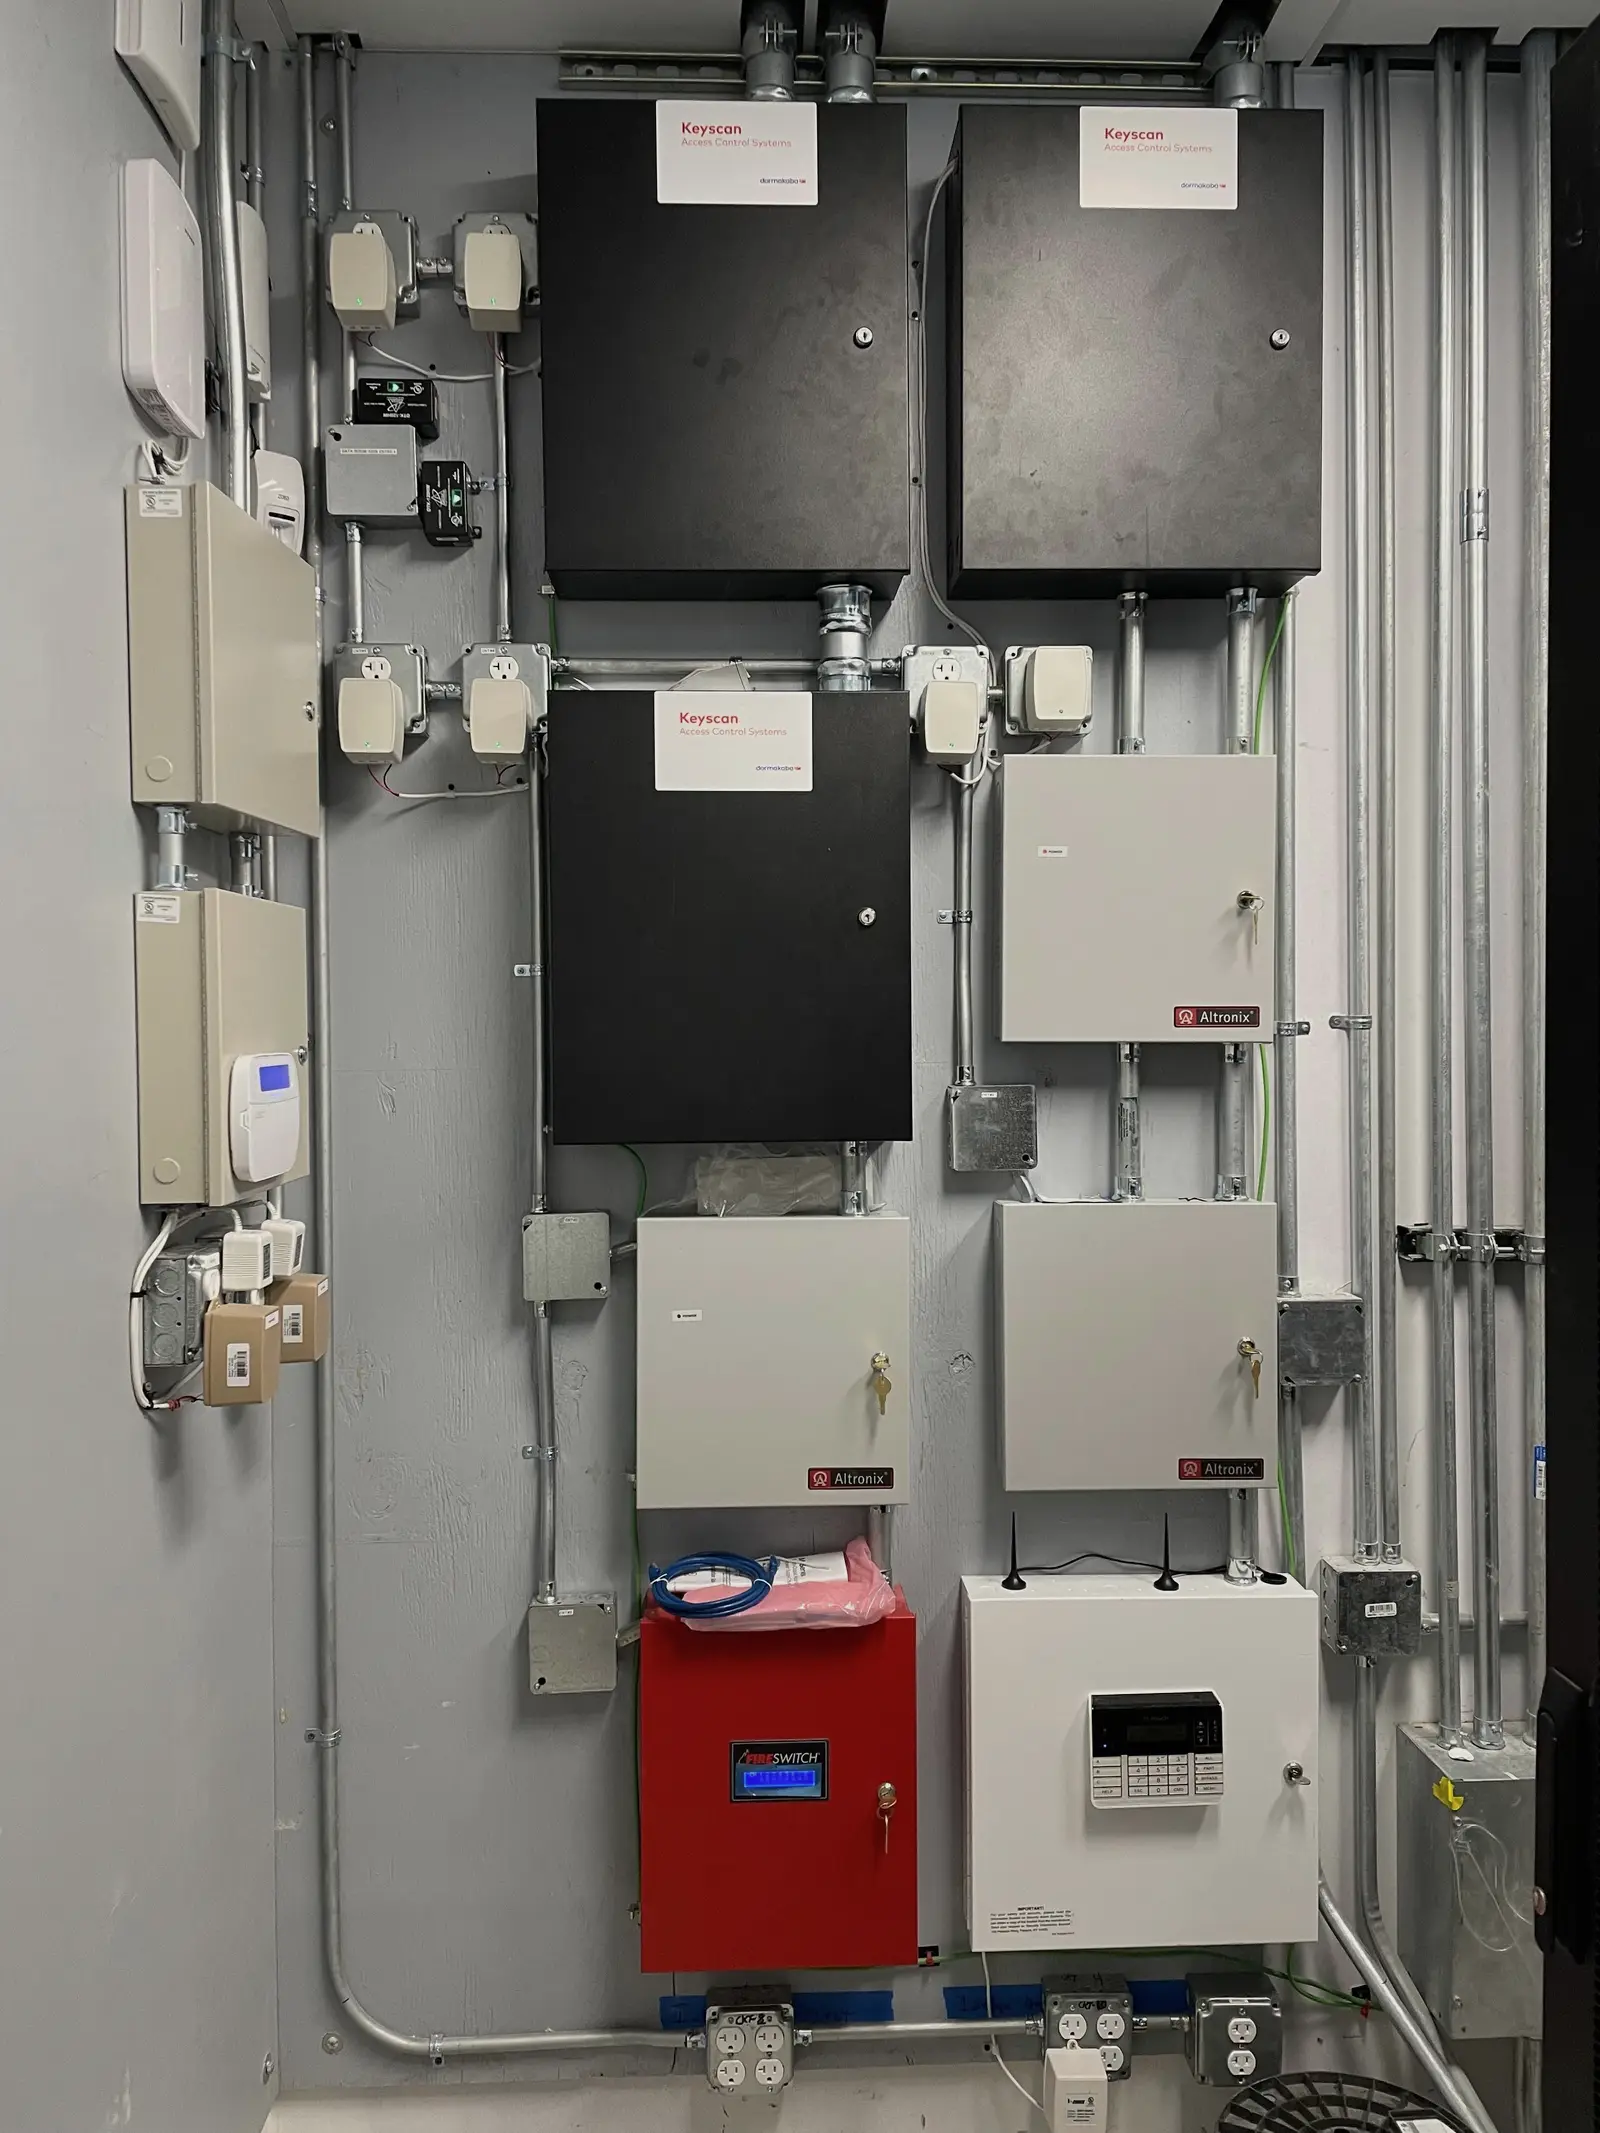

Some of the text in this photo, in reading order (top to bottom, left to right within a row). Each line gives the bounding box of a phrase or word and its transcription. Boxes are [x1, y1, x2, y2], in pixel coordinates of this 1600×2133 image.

[681, 121, 742, 137] Keyscan
[1104, 127, 1164, 142] Keyscan
[680, 138, 792, 149] Access Control Systems
[1104, 143, 1213, 153] Access Control Systems
[759, 177, 799, 185] dormakaba
[1180, 181, 1219, 189] dormakaba
[679, 712, 739, 726] Keyscan
[679, 727, 787, 738] Access Control Systems
[1200, 1010, 1250, 1023] Altronix
[1204, 1463, 1254, 1475] Altronix
[834, 1472, 884, 1485] Altronix
